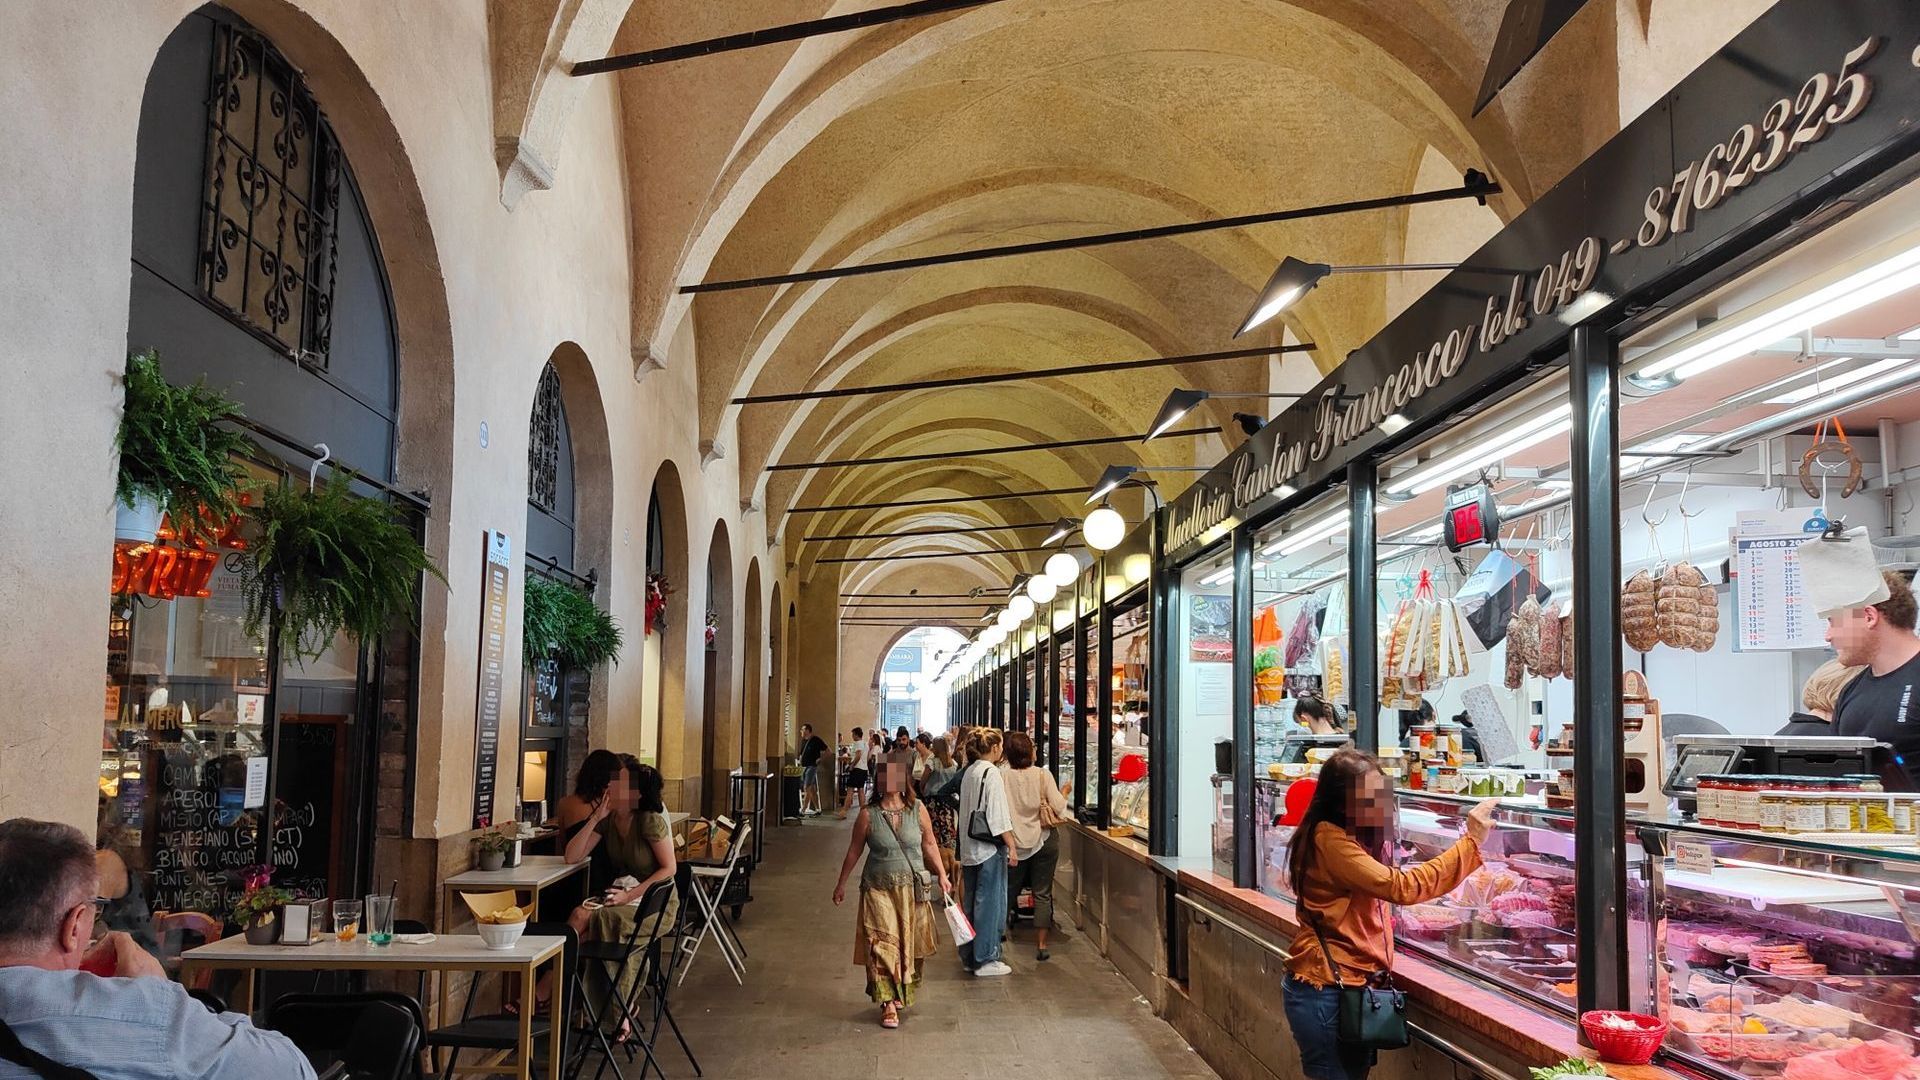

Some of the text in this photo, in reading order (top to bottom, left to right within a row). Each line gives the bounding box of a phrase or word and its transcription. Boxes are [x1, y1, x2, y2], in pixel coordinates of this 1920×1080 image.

[1163, 488, 1231, 556] Macelleria
[1232, 432, 1307, 509] Canton
[1310, 324, 1475, 462] Francesco
[1480, 274, 1527, 352] tel.
[1534, 236, 1600, 315] 049
[1637, 35, 1880, 247] 8762325
[1749, 541, 1786, 549] AGOSTO
[163, 789, 224, 810] APEROL
